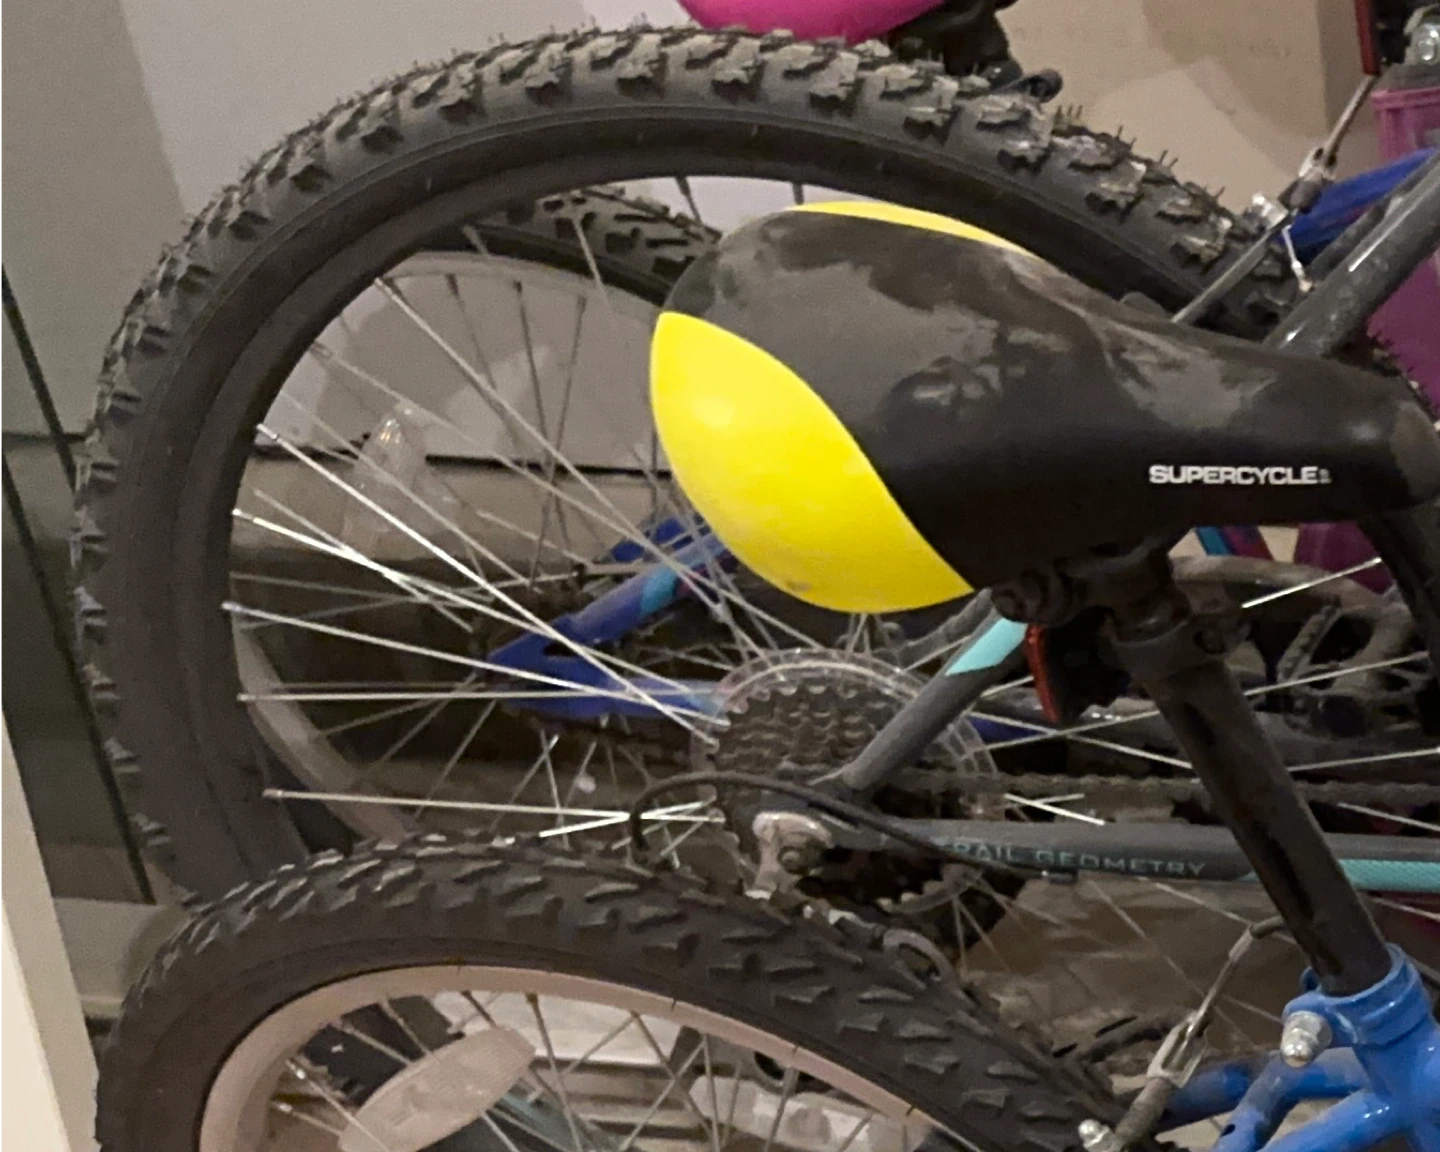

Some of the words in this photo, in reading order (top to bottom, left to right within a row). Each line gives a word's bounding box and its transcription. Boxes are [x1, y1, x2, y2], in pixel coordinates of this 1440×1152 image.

[1149, 465, 1319, 485] SUPERCYCLE
[943, 842, 1023, 863] TRAIL
[1035, 849, 1206, 876] GEOMETRY
